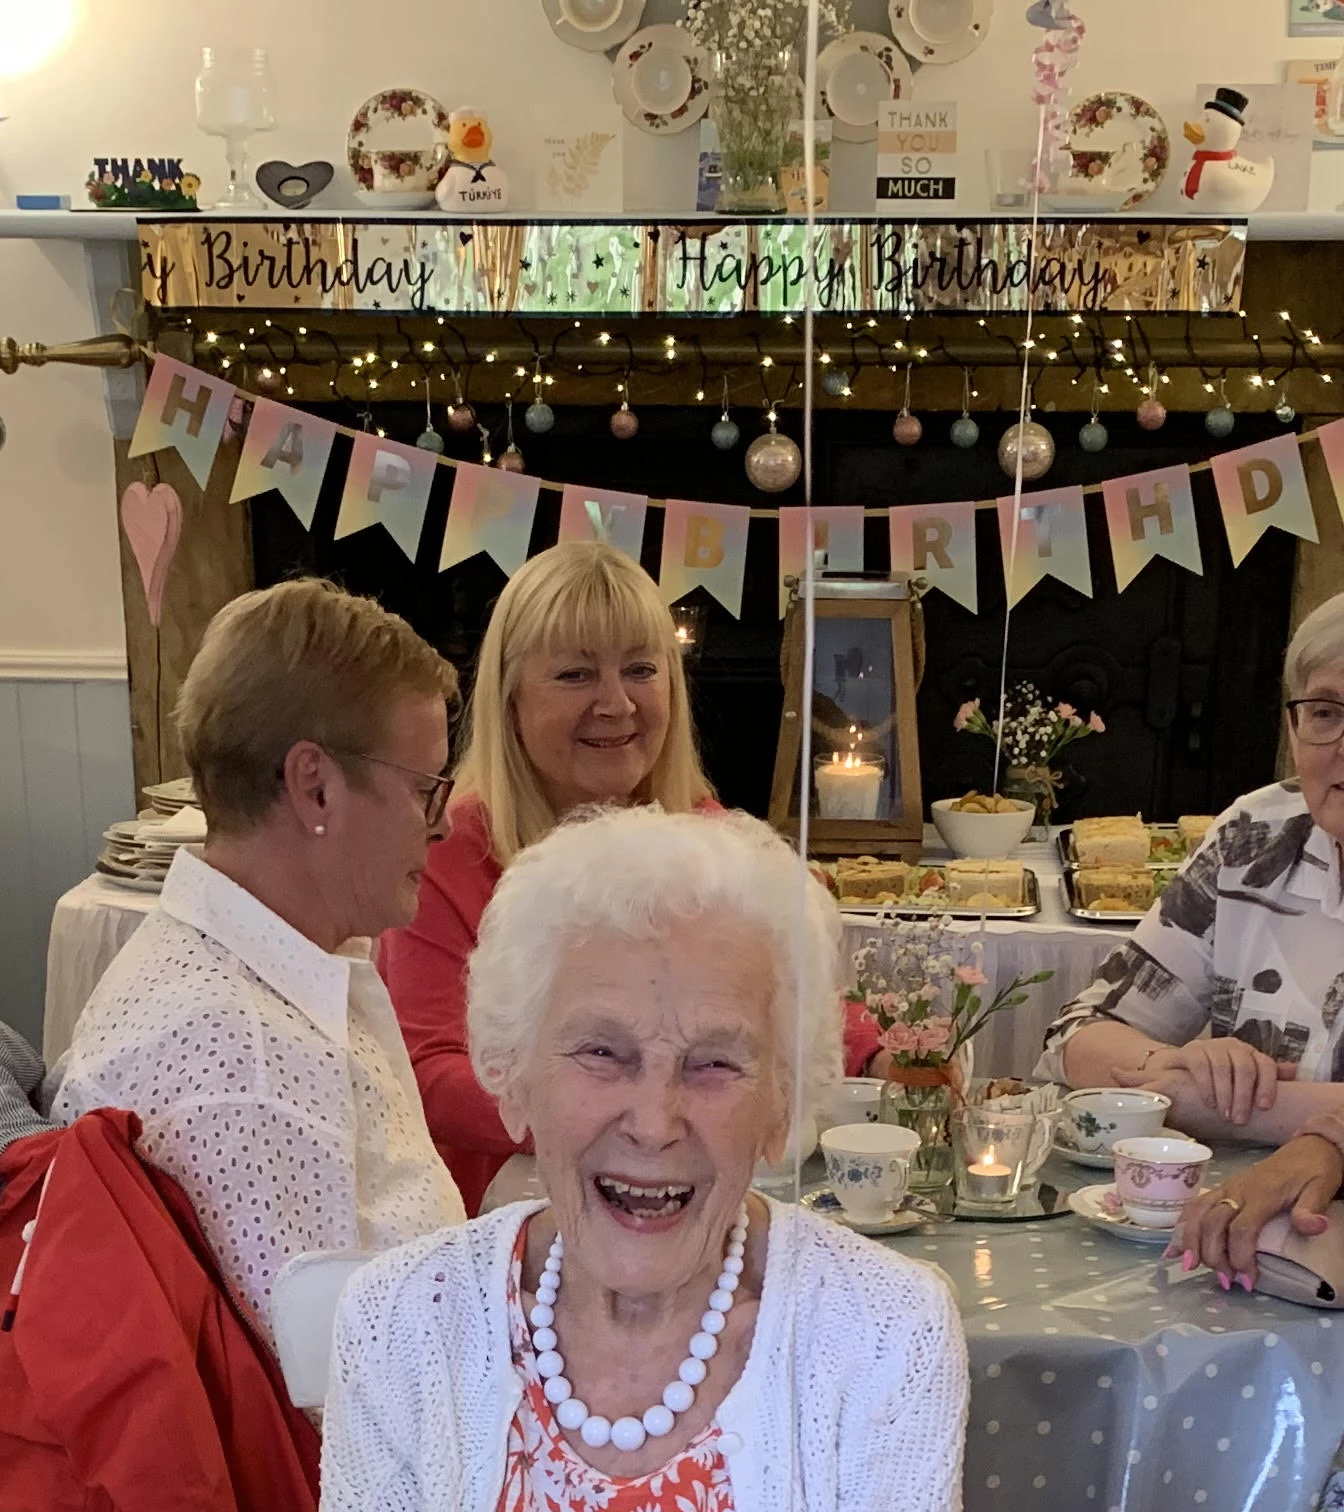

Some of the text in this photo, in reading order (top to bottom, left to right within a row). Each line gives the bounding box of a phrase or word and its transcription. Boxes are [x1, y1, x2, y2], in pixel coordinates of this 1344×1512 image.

[887, 111, 949, 129] THANK
[896, 133, 940, 151] YOU
[93, 157, 185, 187] THANK
[901, 156, 933, 175] SO
[887, 179, 944, 197] MUCH
[201, 230, 435, 310] Birthday
[674, 229, 844, 309] Happy
[870, 230, 1109, 310] Birthday
[158, 372, 628, 543] HAPPY
